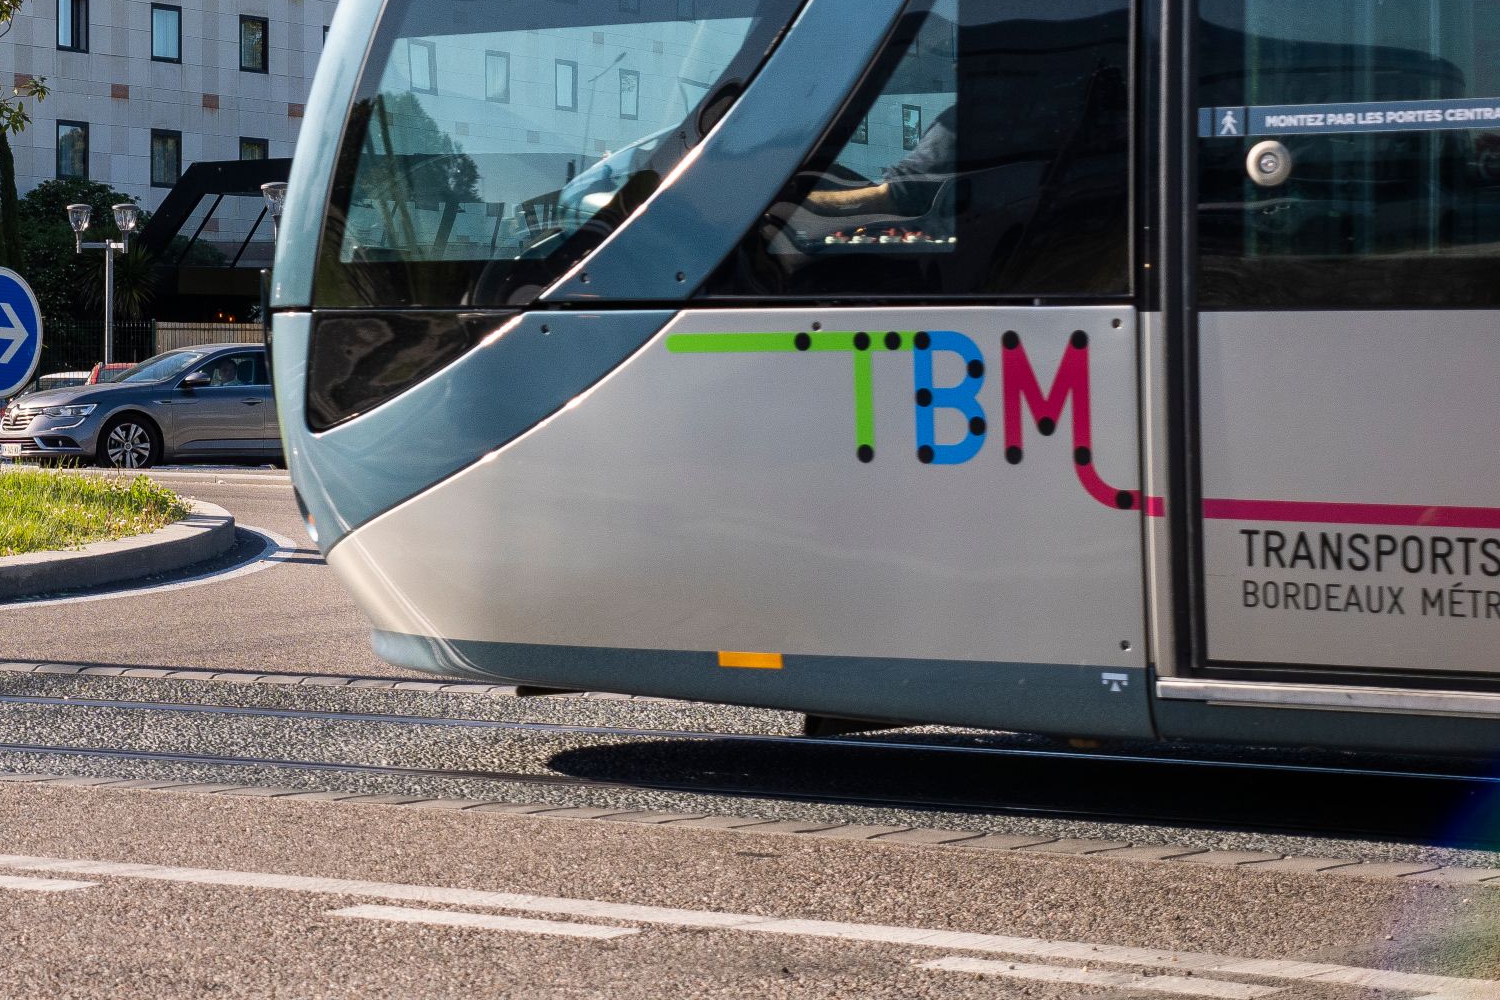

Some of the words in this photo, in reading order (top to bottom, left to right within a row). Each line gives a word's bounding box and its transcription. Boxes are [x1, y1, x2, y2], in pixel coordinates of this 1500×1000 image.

[1265, 114, 1325, 127] MONTEZ
[1326, 113, 1356, 125] PAR
[1357, 111, 1384, 124] LES
[1385, 109, 1443, 123] PORTES
[666, 329, 1092, 466] TBM
[1238, 528, 1500, 577] TRANSPORTS
[1242, 579, 1405, 615] BORDEAUX
[1421, 581, 1500, 619] MÉTR
